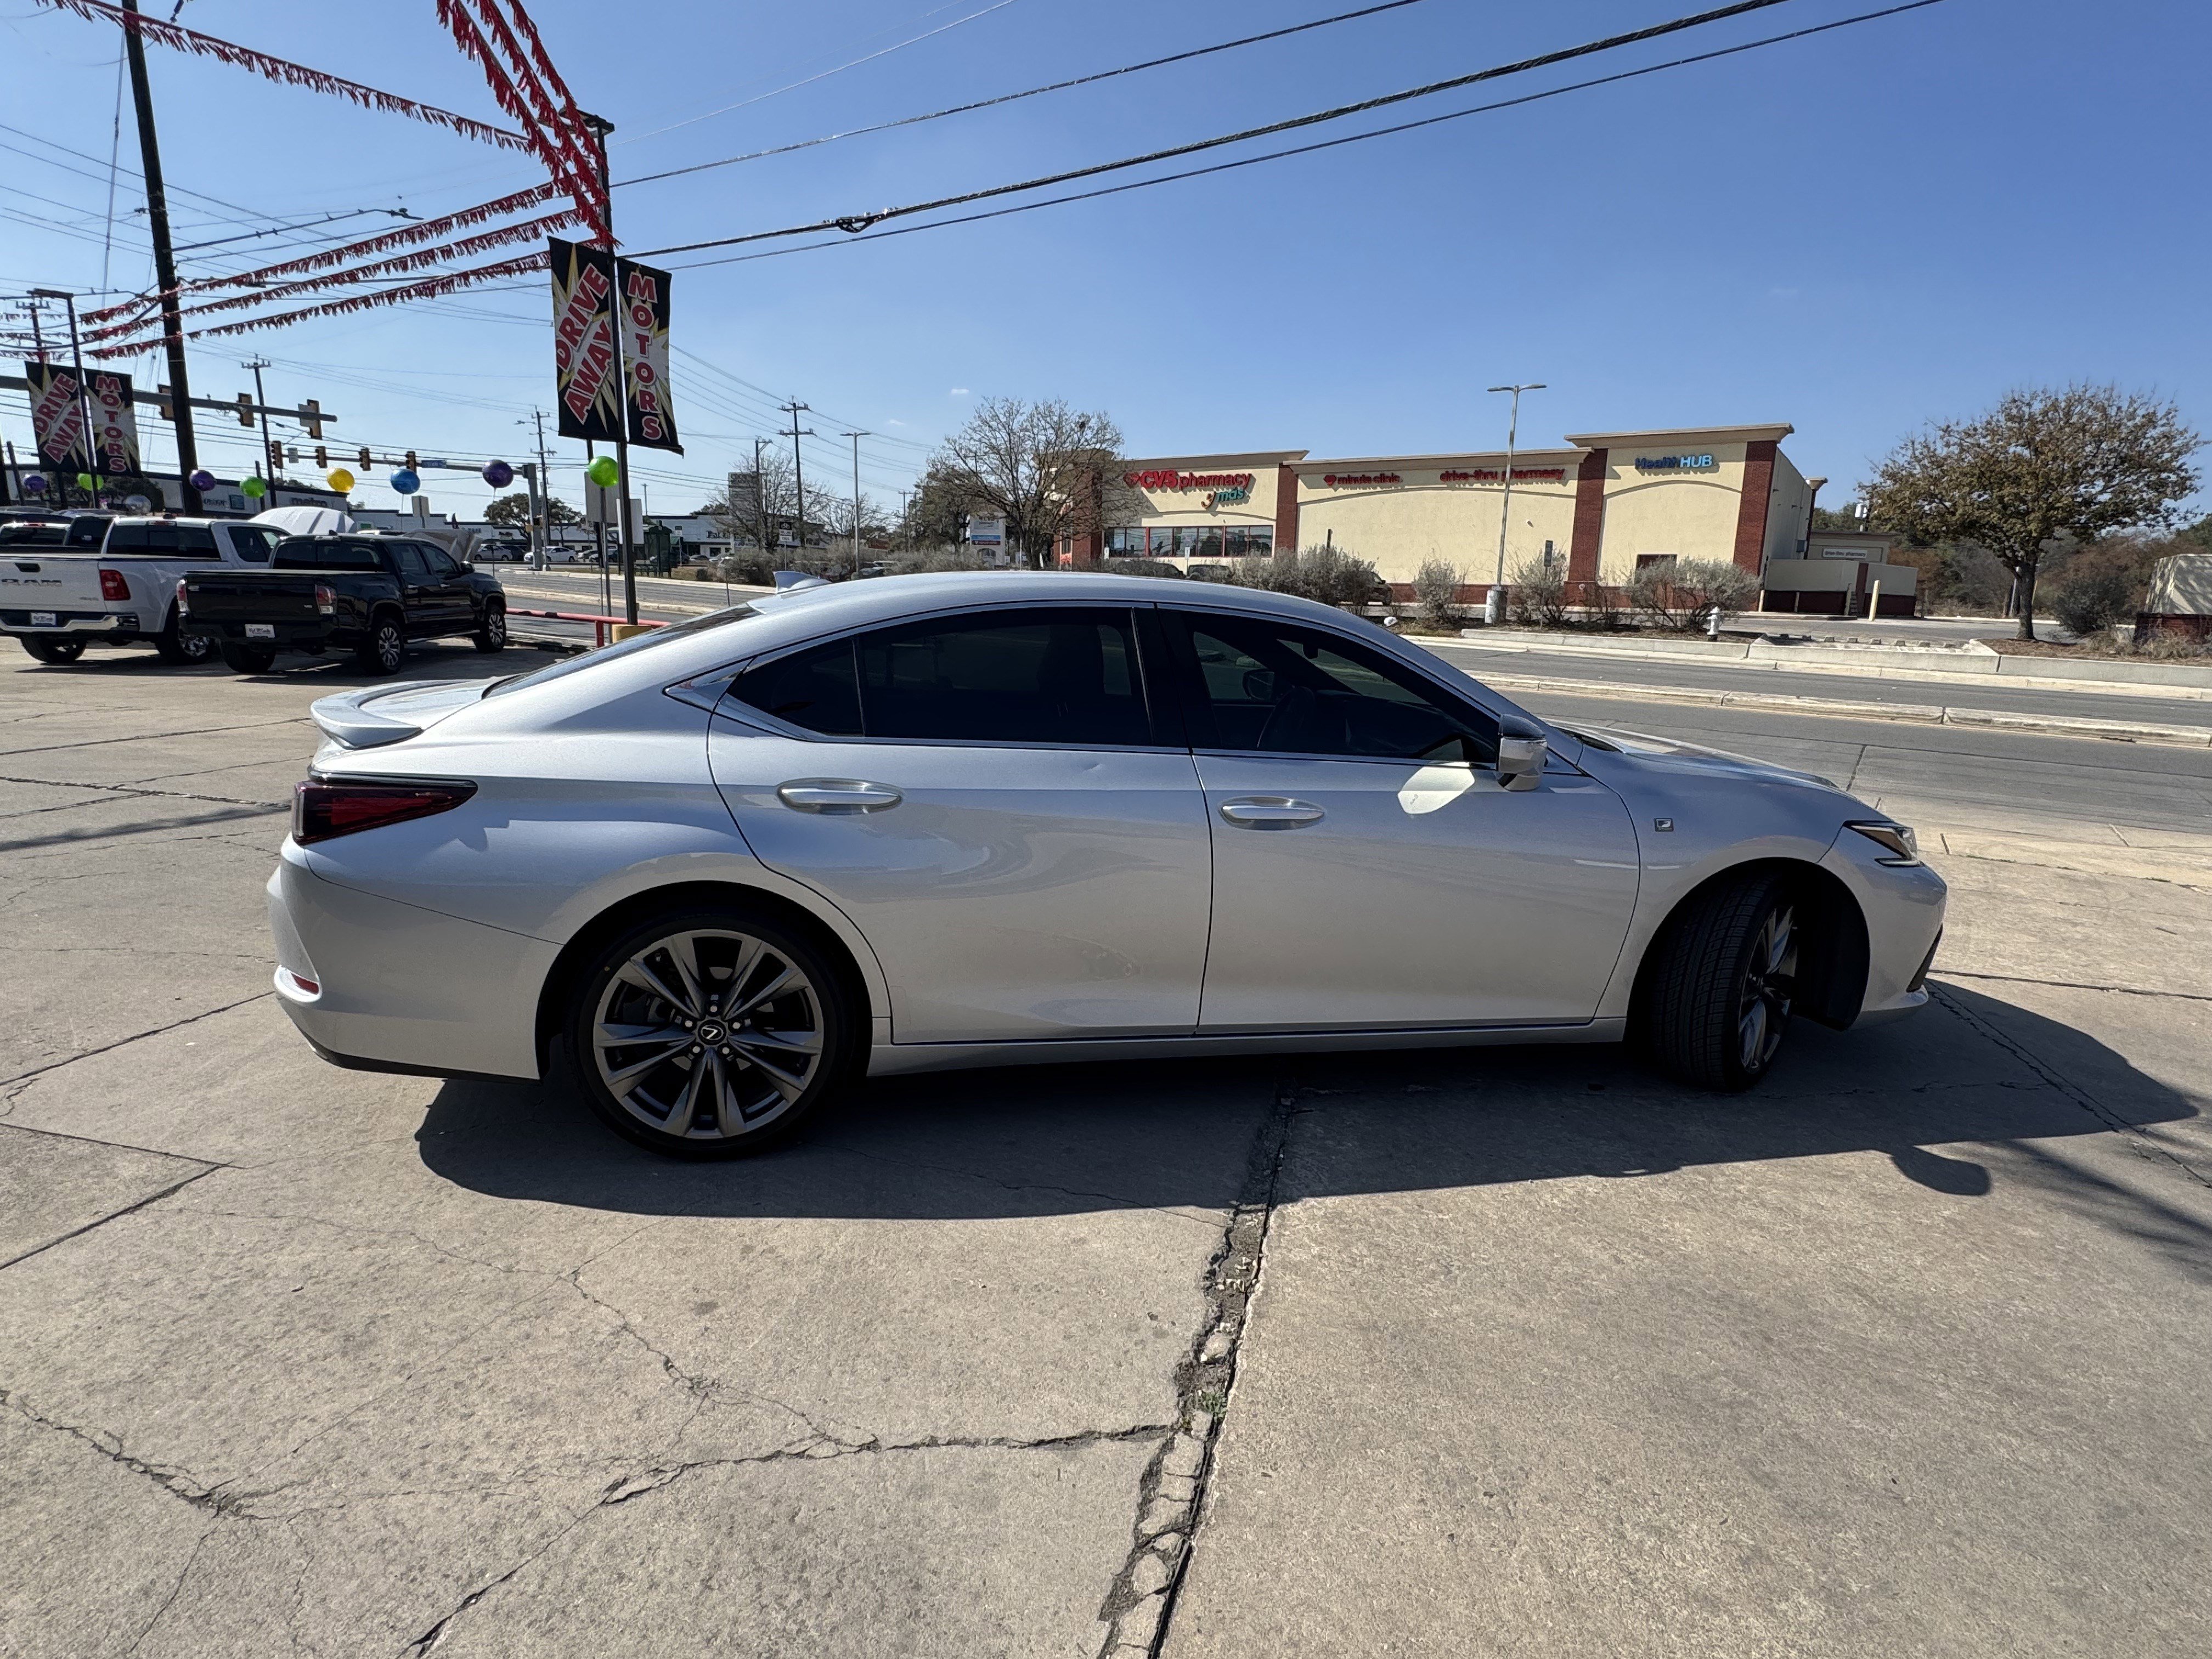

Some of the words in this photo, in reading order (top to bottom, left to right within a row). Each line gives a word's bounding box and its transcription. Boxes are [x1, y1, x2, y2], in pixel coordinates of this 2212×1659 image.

[556, 263, 610, 374] DRIVE
[627, 271, 662, 441] MOTORS
[35, 373, 78, 434] DRIVE
[564, 320, 612, 425] AWAY
[43, 404, 82, 464] AWAY
[95, 375, 126, 472] MOTORS
[1140, 470, 1179, 489] CVS
[1179, 471, 1253, 491] pharmacy
